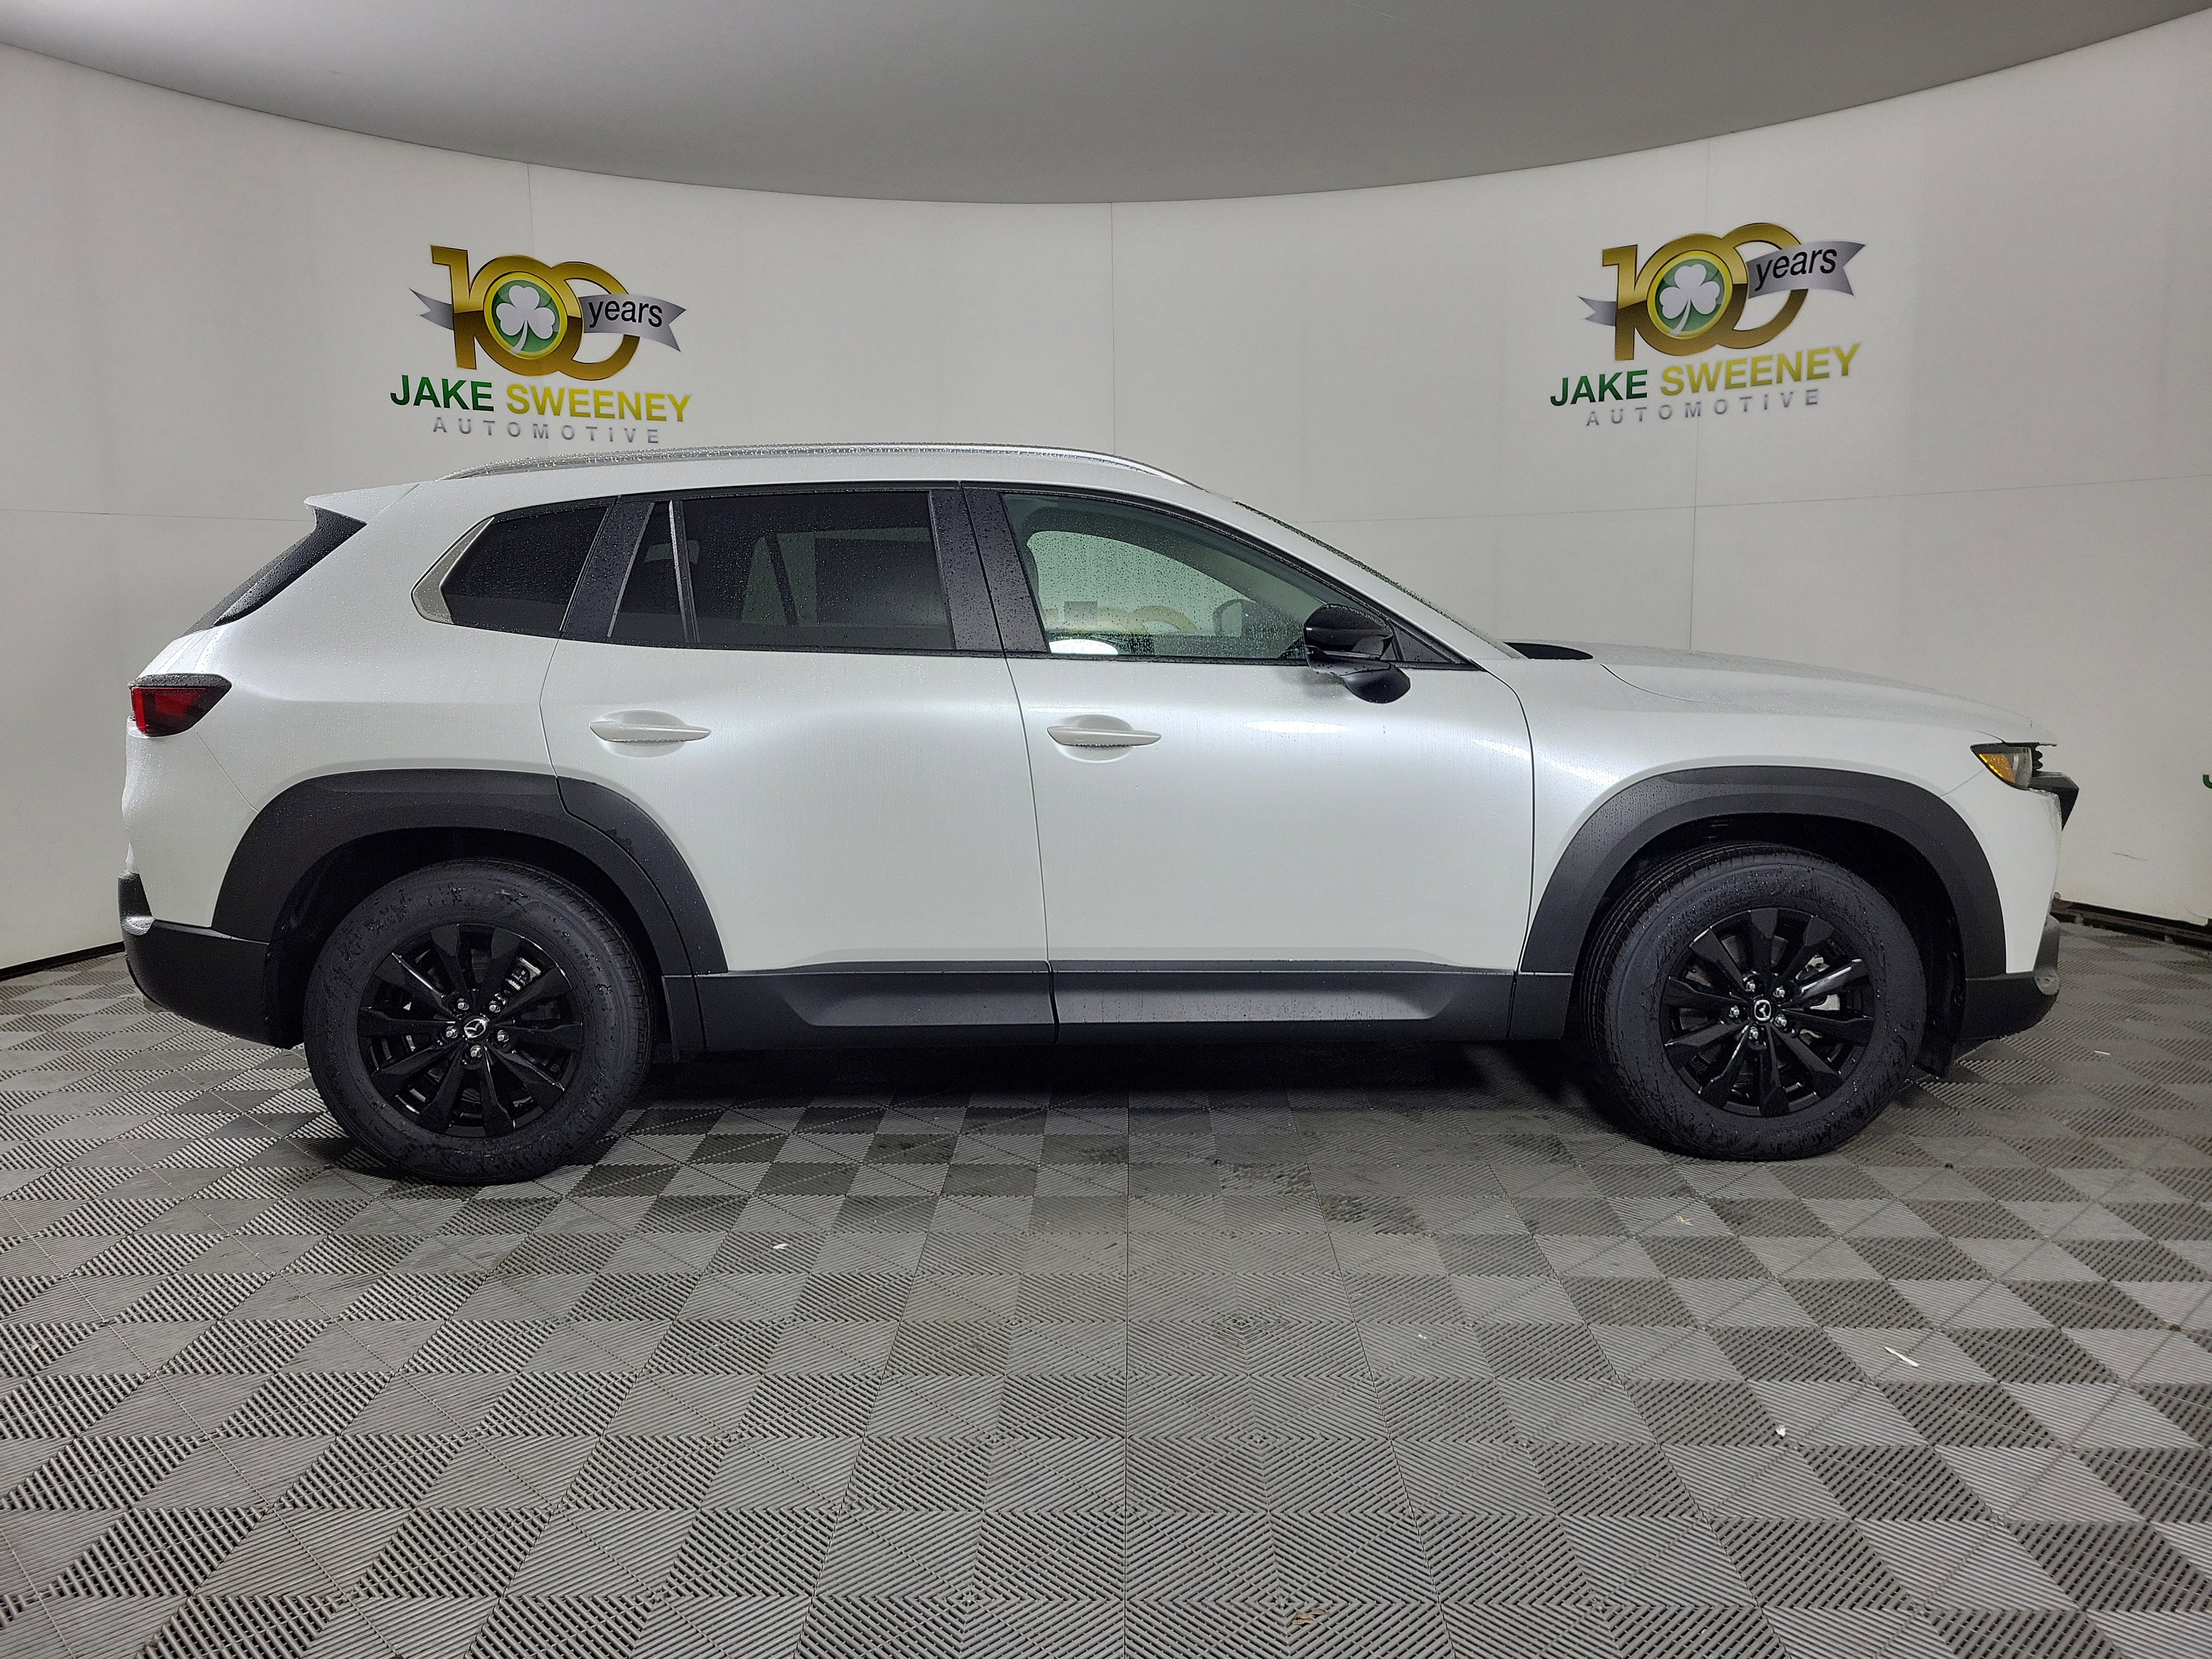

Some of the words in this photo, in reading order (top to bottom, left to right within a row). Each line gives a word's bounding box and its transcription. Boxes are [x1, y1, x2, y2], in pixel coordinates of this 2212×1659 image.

[1755, 248, 1838, 291] years
[588, 300, 663, 328] years
[1549, 369, 1647, 407] JAKE
[1660, 342, 1861, 397] SWEENEY
[390, 374, 495, 412] JAKE
[506, 383, 692, 422] SWEENEY
[1585, 388, 1819, 427] AUTOMOTIVE
[432, 416, 659, 444] AUTOMOTIVE
